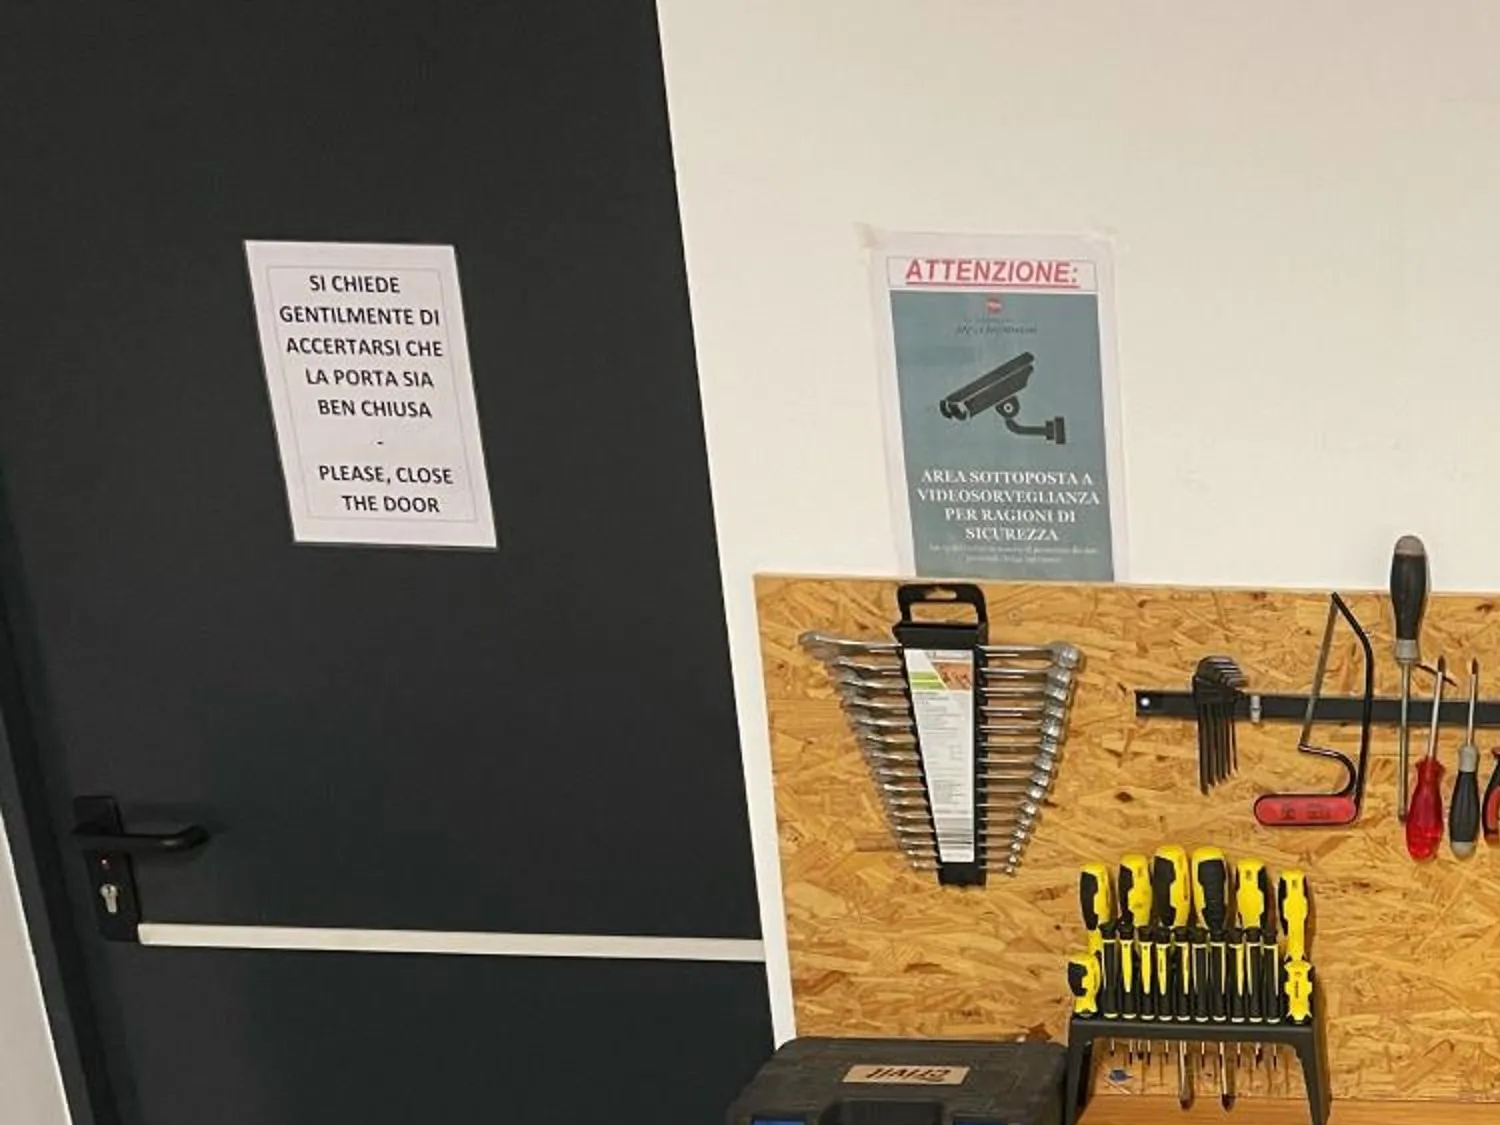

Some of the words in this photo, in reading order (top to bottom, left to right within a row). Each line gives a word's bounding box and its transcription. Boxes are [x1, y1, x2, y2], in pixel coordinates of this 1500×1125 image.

[905, 259, 1079, 284] ATTENZIONE:
[309, 275, 325, 291] SI
[332, 276, 400, 293] CHIEDE
[279, 305, 414, 325] GENTILMENTE
[420, 309, 440, 325] DI
[286, 337, 401, 356] ACCERTARSI
[406, 340, 443, 357] CHE
[305, 369, 329, 385] LA
[335, 369, 398, 387] PORTA
[404, 371, 434, 388] SIA
[318, 399, 355, 416] BEN
[361, 400, 432, 418] CHIUSA
[319, 465, 391, 485] PLEASE,
[396, 467, 453, 484] CLOSE
[921, 469, 967, 483] AREA
[969, 470, 1078, 485] SOTTOPOSTA
[1083, 473, 1094, 486] A
[342, 495, 378, 511] THE
[384, 496, 440, 513] DOOR
[916, 488, 1100, 505] VIDEOSORVEGLIANZA
[944, 507, 978, 521] PER
[981, 508, 1053, 523] RAGIONI
[1057, 509, 1076, 523] DI
[965, 527, 1060, 542] SICUREZZA
